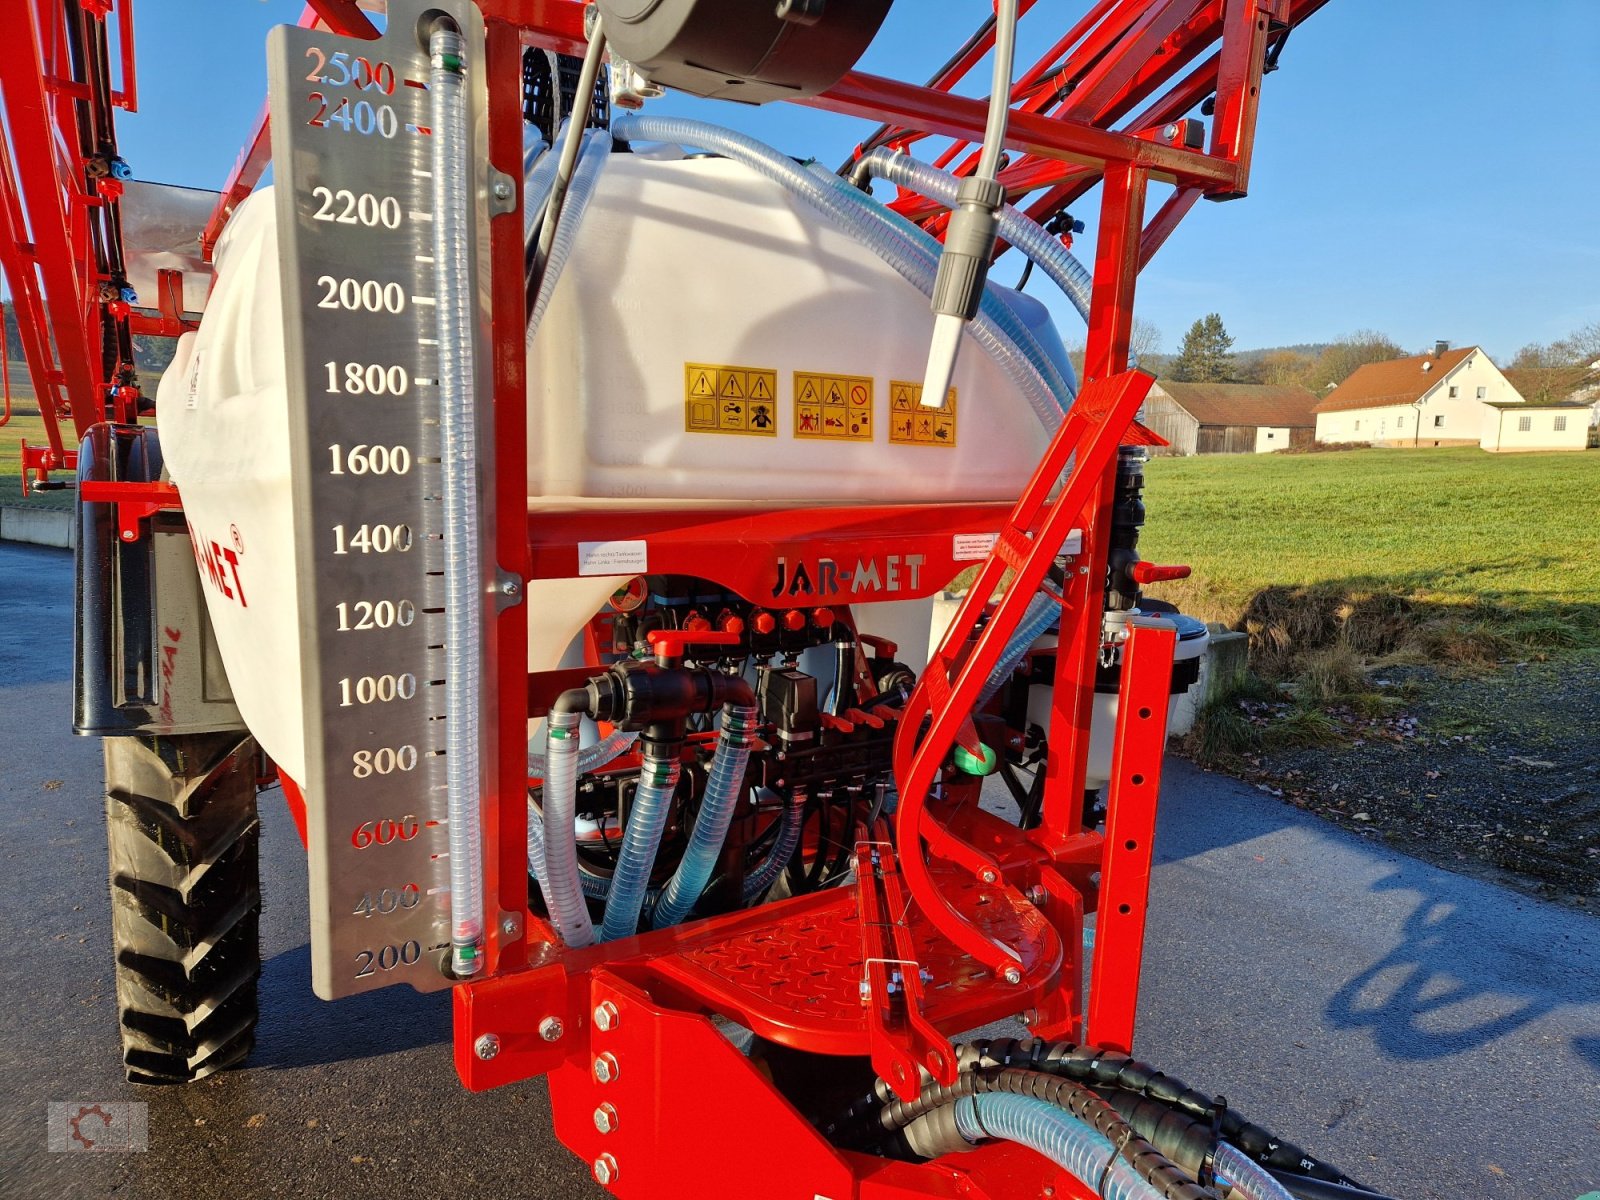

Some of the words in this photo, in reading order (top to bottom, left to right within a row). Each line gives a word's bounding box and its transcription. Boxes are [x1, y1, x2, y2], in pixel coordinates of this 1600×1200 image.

[305, 46, 396, 96] 2500
[306, 91, 398, 139] 2400
[312, 186, 401, 229] 2200
[317, 276, 405, 314] 2000
[324, 361, 408, 396] 1800
[328, 444, 411, 476] 1600
[332, 523, 413, 555] 1400
[771, 554, 926, 598] JAR-MET
[335, 599, 414, 632] 1200
[338, 672, 417, 707] 1000
[352, 744, 418, 779] 800
[351, 814, 419, 850] 600
[353, 882, 420, 919] 400
[354, 939, 421, 979] 200
